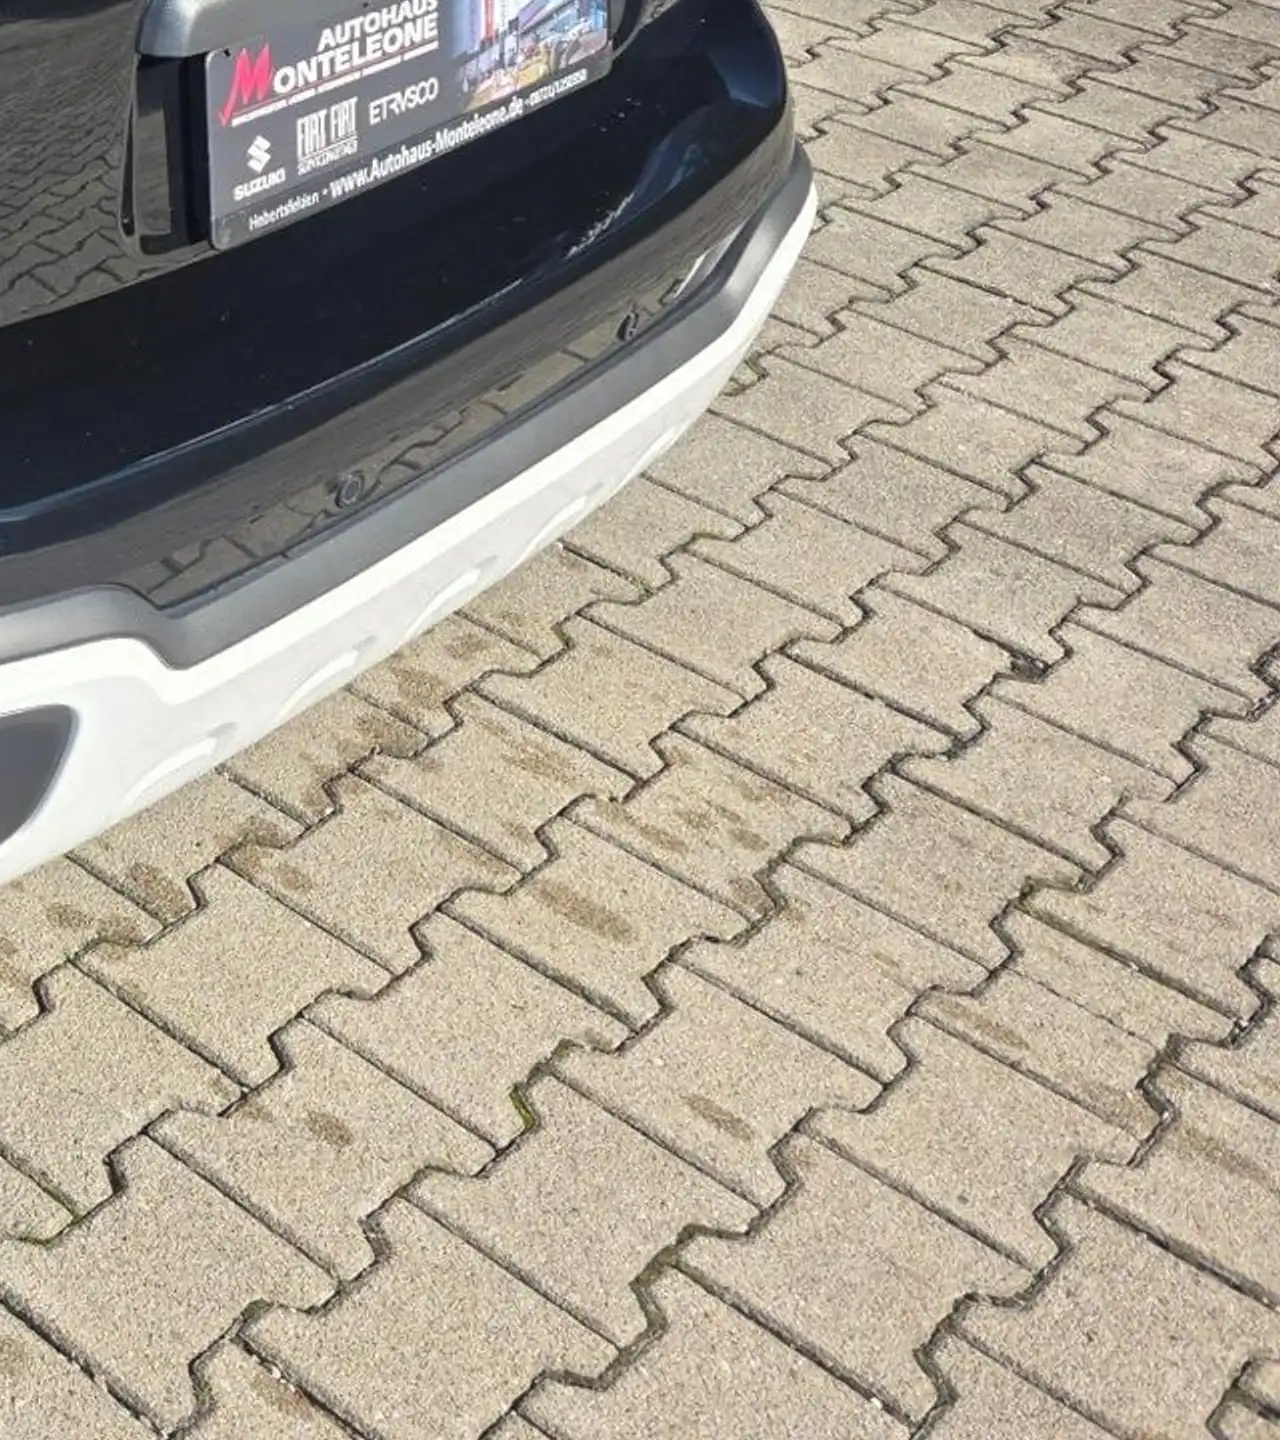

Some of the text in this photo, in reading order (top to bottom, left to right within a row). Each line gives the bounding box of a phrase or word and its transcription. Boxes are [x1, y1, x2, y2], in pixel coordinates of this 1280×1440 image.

[219, 13, 439, 127] MONTELEONE
[232, 167, 286, 201] SUZUKI
[329, 95, 524, 199] www.Autohaus-Monteleone.de
